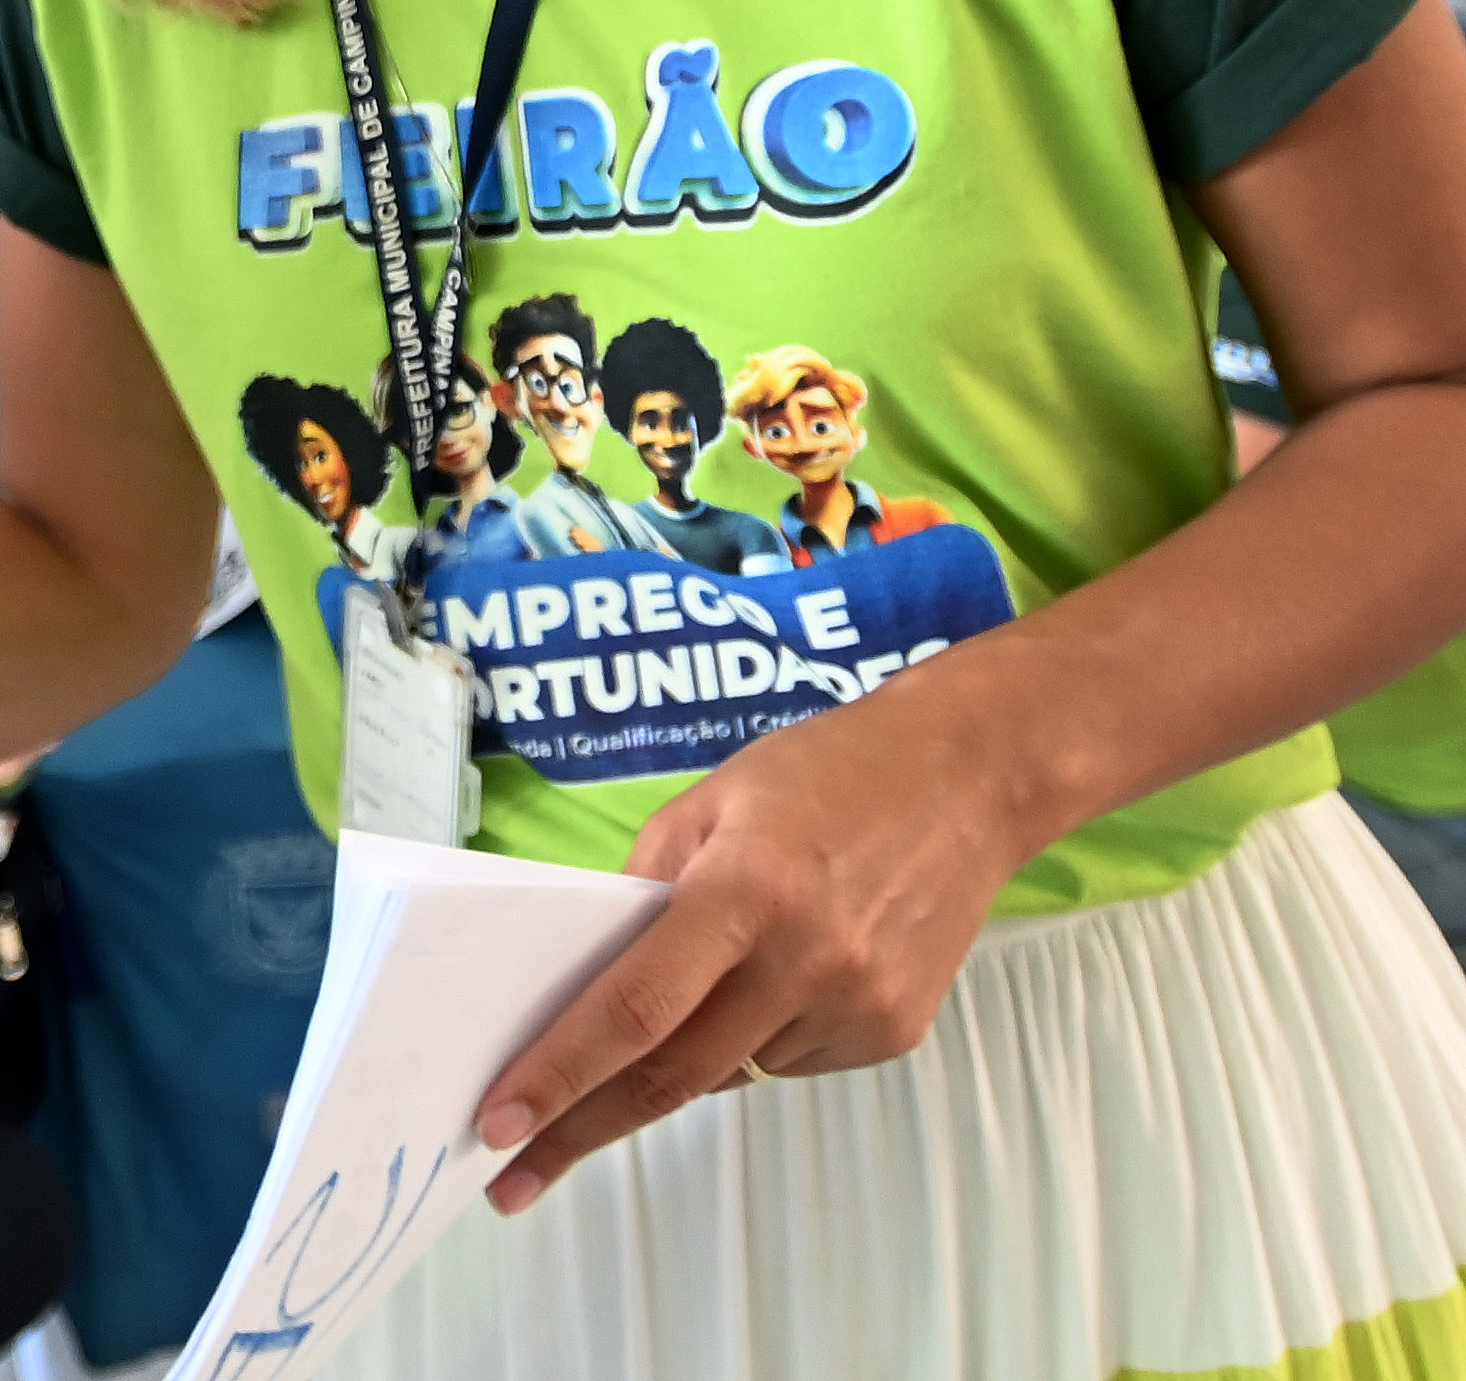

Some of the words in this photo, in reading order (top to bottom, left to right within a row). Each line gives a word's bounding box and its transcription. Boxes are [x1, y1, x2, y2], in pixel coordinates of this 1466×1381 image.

[235, 39, 918, 248] FEIRÃO
[354, 97, 384, 142] DE
[368, 140, 412, 295] MUNICIPAL
[390, 294, 435, 471] PREFEITURA
[795, 587, 860, 651] E
[570, 718, 732, 759] Qualificação
